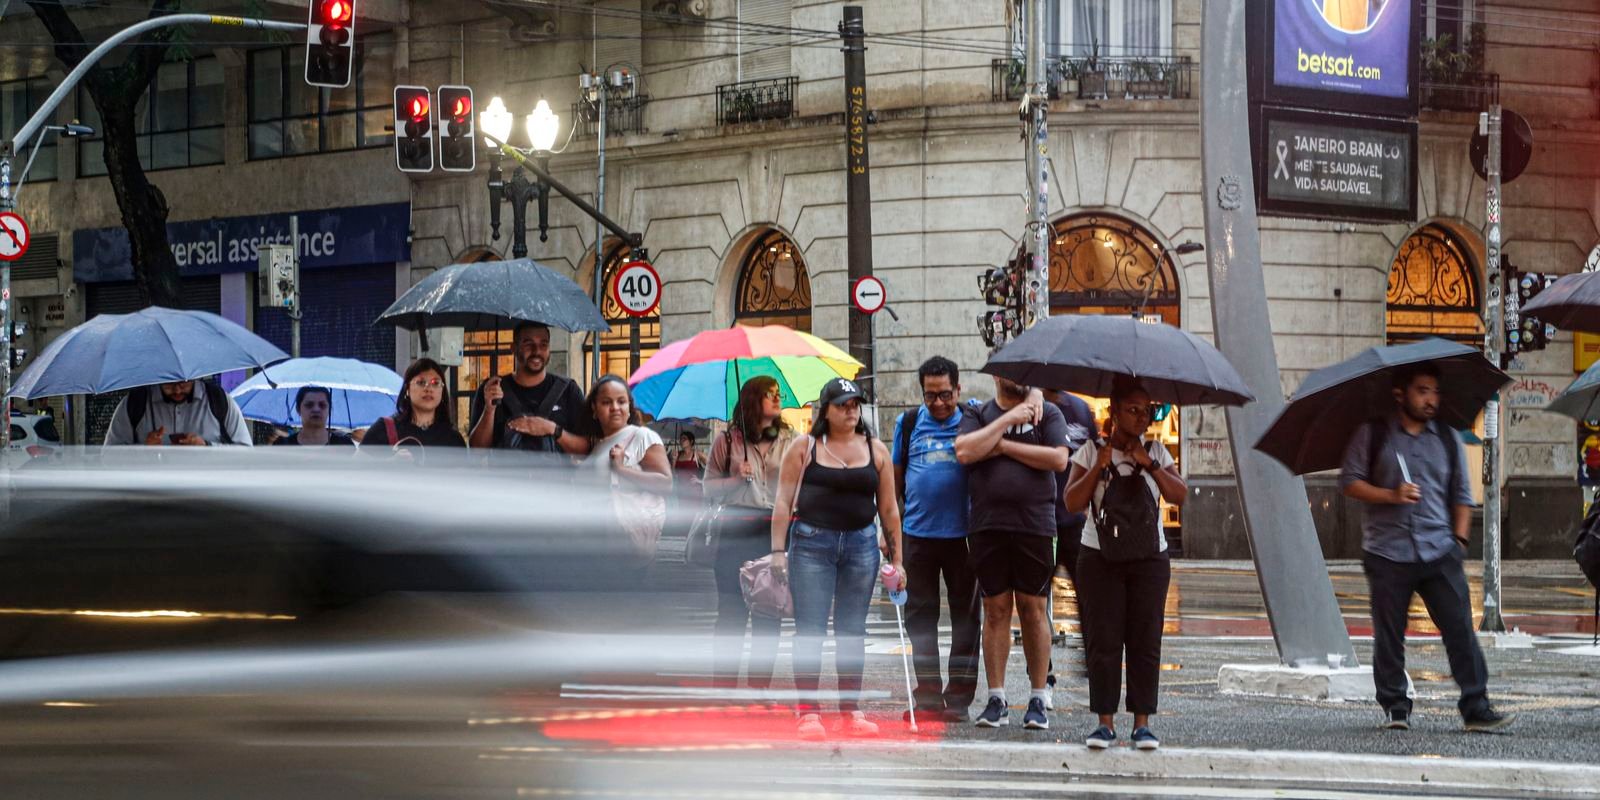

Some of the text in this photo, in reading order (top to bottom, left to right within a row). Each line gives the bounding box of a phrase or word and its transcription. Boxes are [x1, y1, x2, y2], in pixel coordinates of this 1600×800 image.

[1298, 48, 1381, 80] betsat.com
[1294, 135, 1400, 159] JANEIRO BRANCO
[1330, 160, 1382, 180] SAUDÁVEL,
[1294, 176, 1371, 195] VIDA SAUDÁVEL
[622, 275, 652, 297] 40
[838, 379, 856, 392] LA
